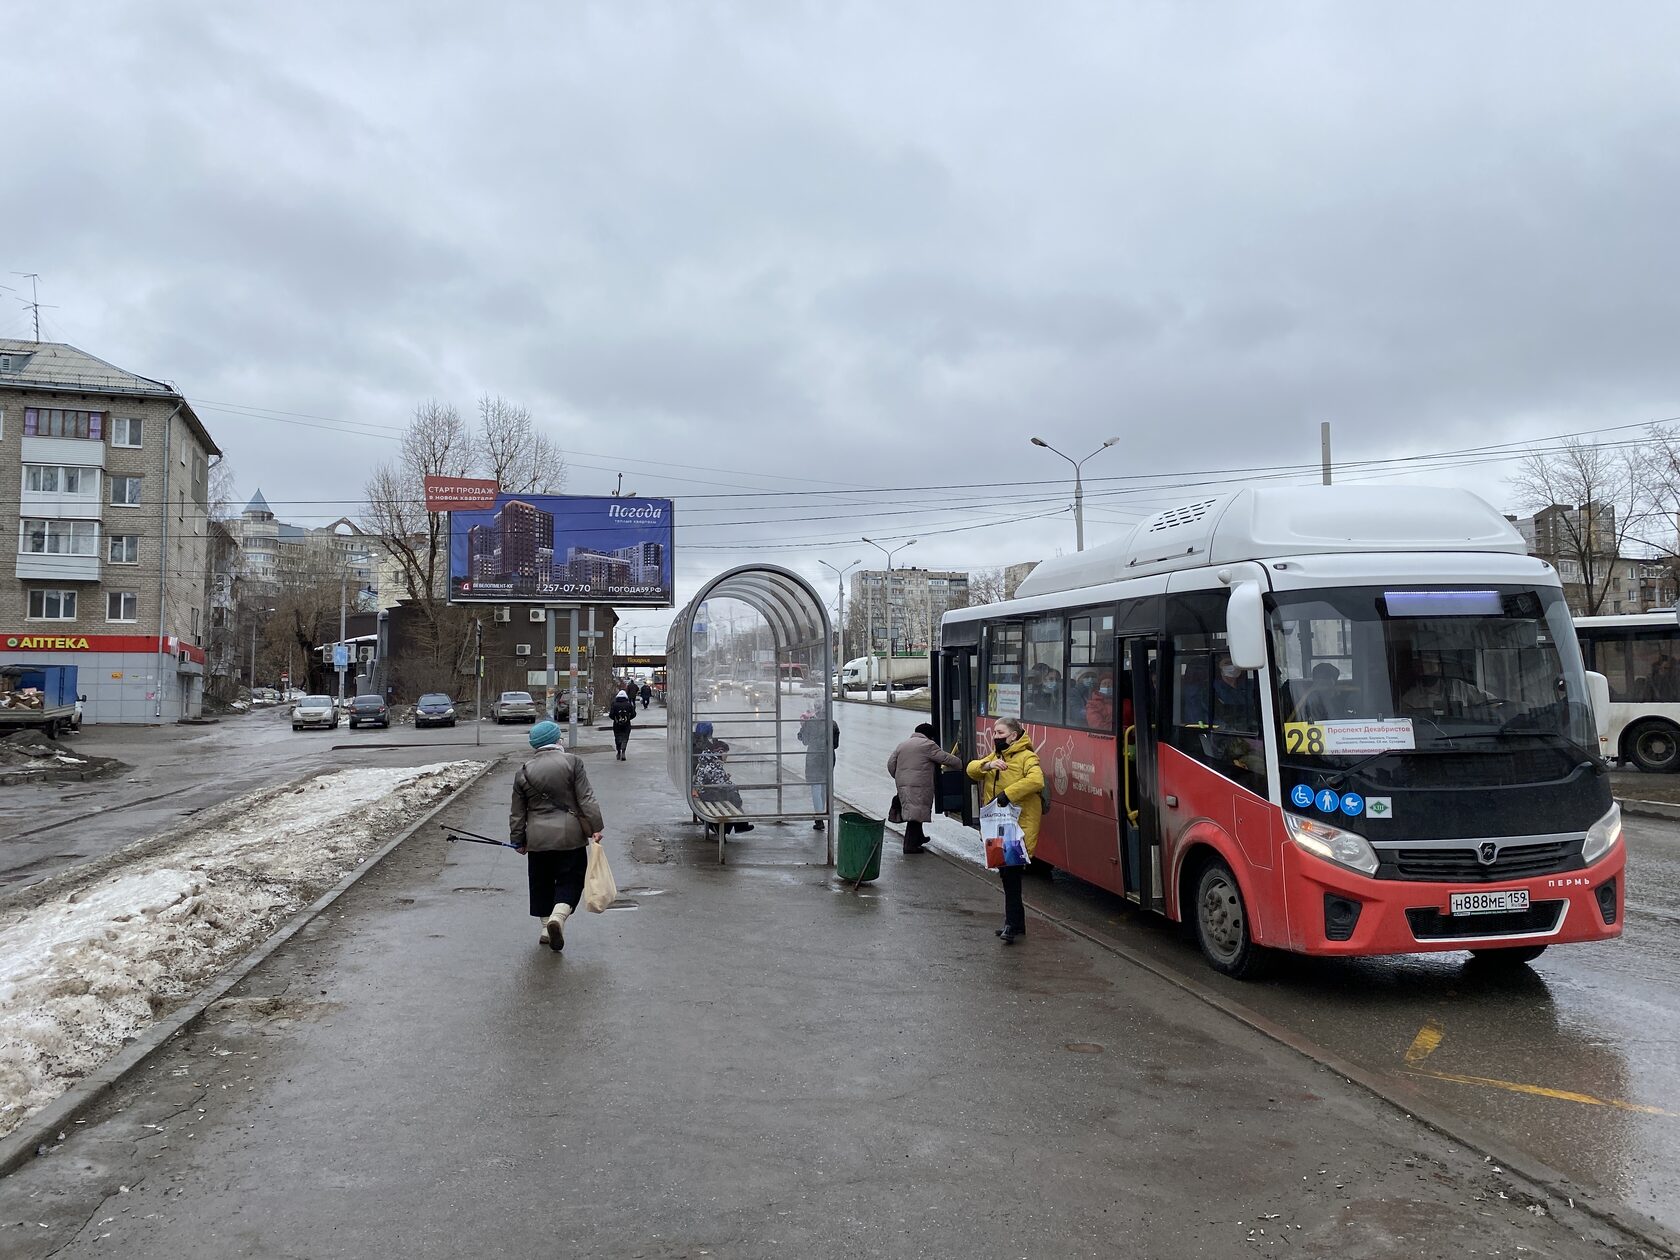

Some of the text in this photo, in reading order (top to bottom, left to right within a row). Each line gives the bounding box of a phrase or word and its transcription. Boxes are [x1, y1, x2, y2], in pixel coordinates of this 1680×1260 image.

[609, 503, 662, 518] Погода
[542, 584, 591, 592] 257-07-70
[20, 637, 89, 649] АПТЕКА
[1287, 728, 1325, 754] 28
[1548, 878, 1590, 887] ПЕРМЬ
[1455, 893, 1526, 910] Н888МЕ 159
